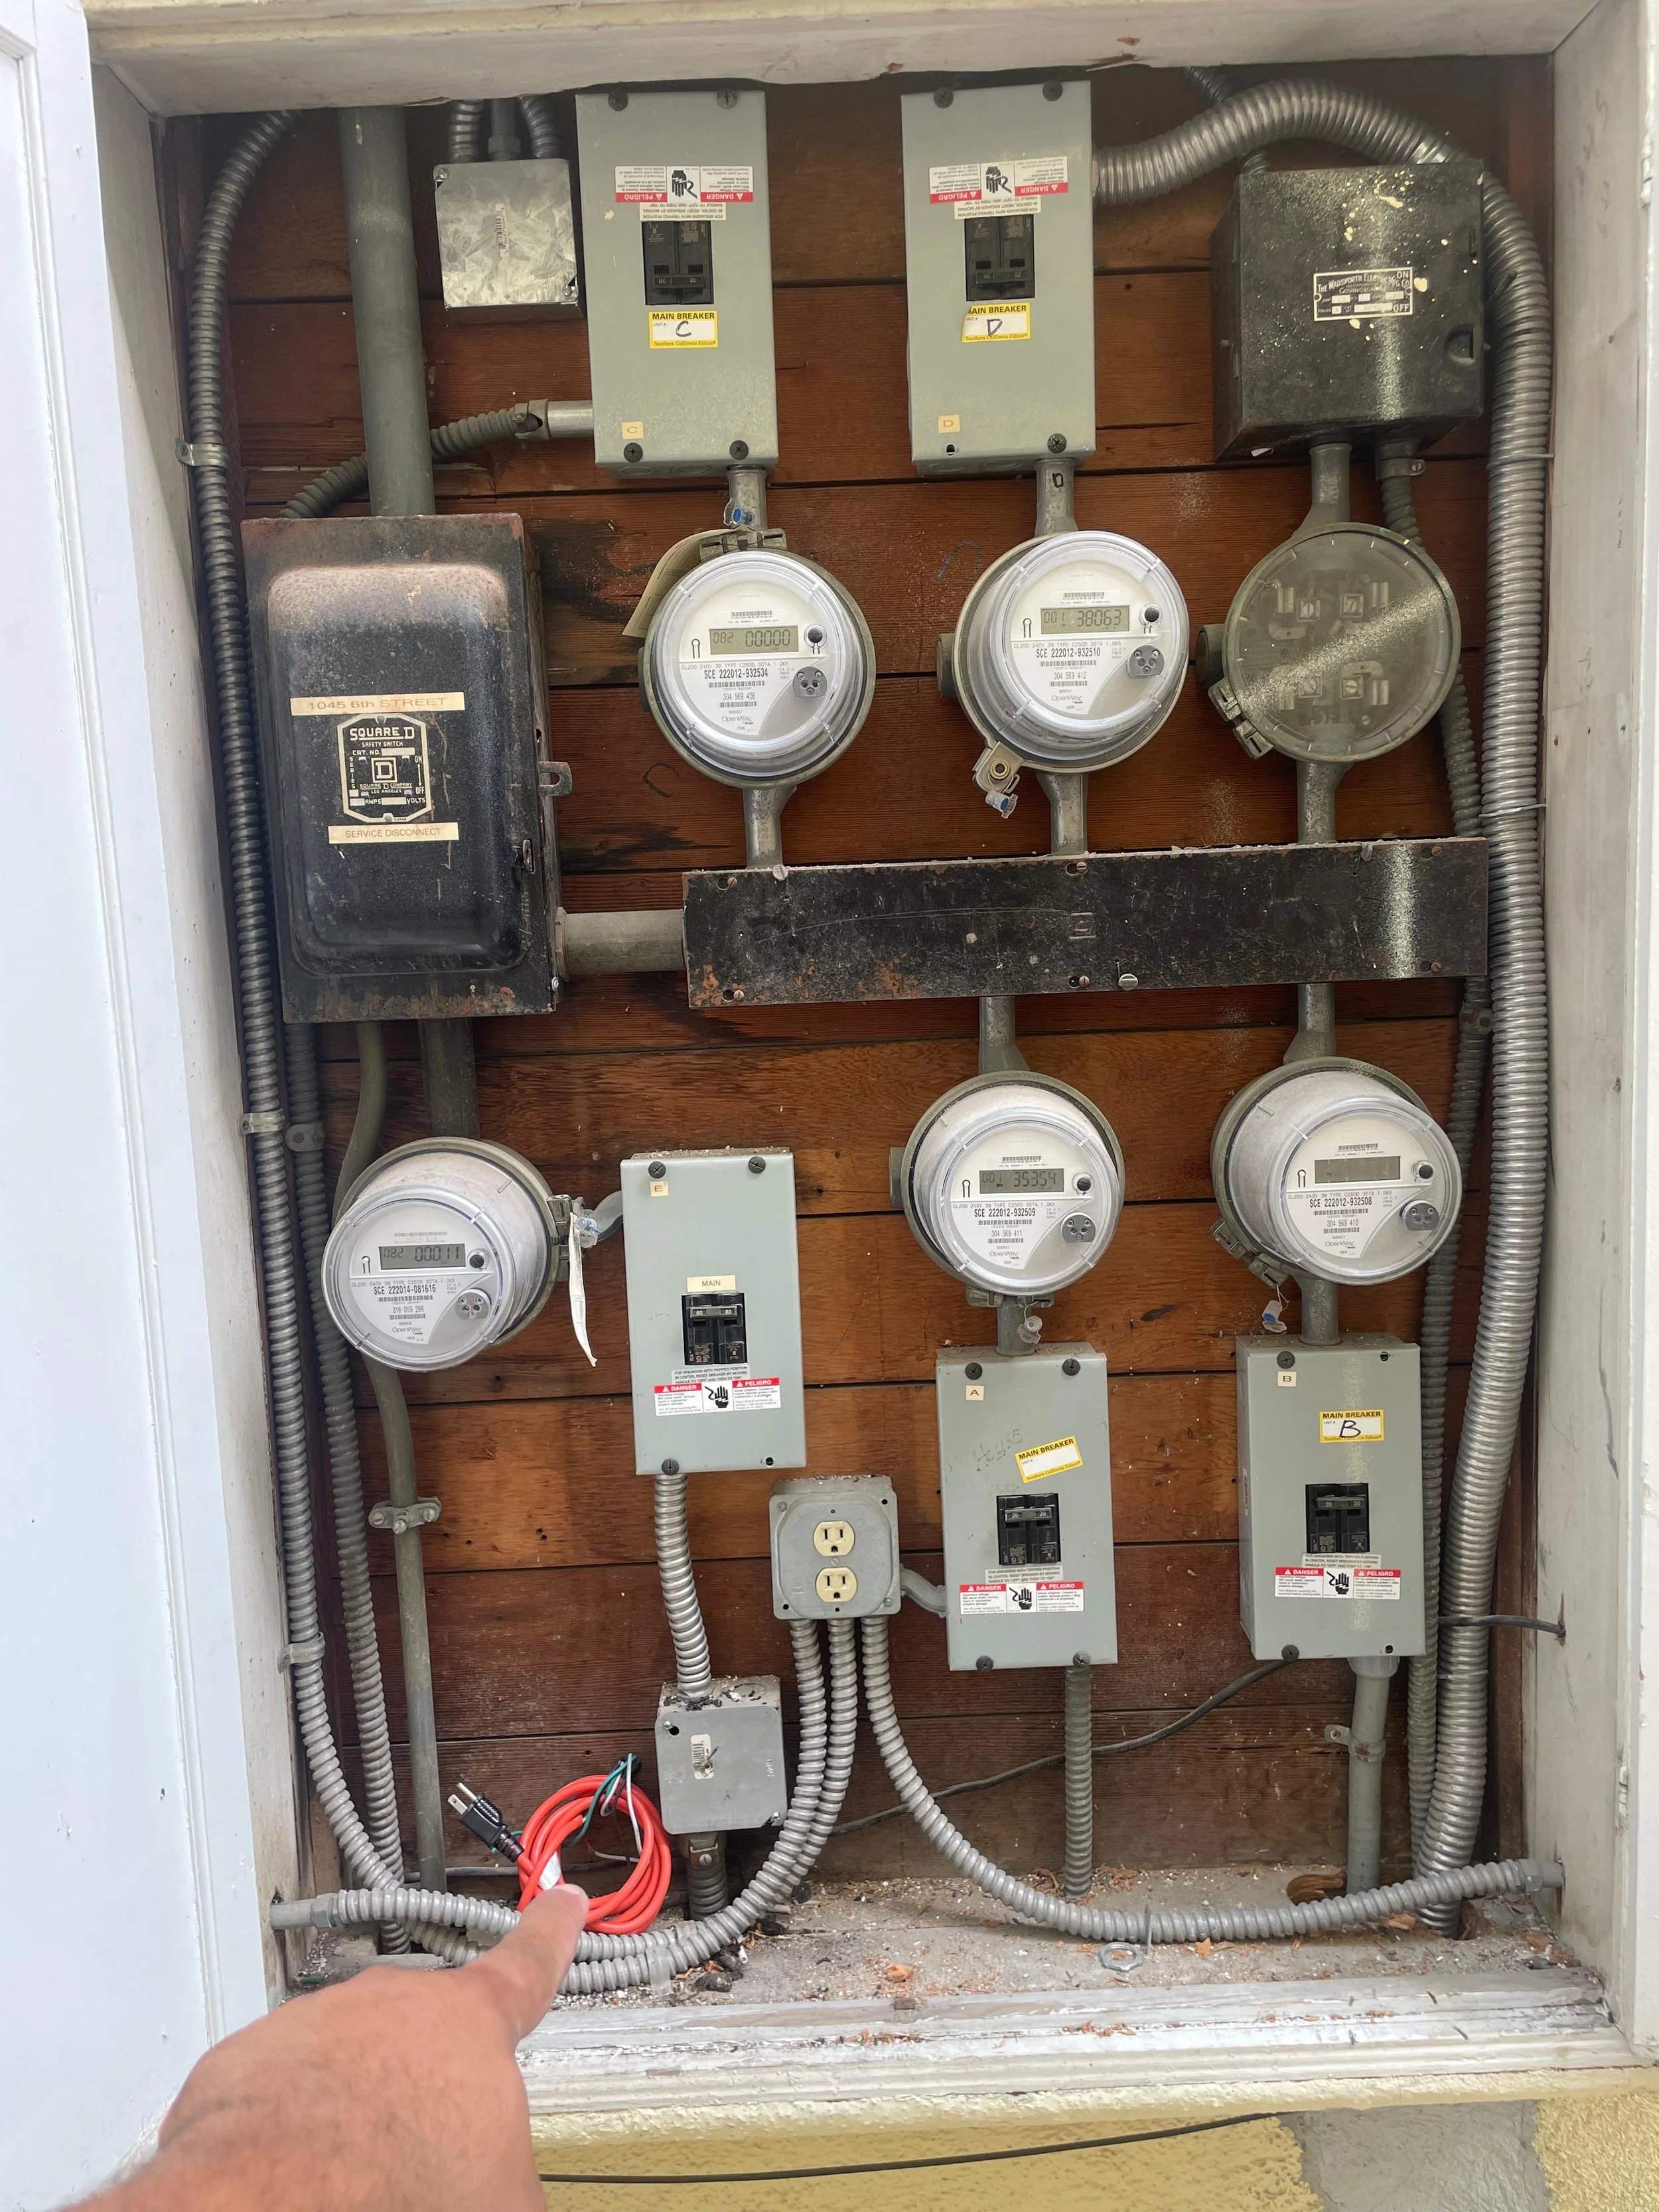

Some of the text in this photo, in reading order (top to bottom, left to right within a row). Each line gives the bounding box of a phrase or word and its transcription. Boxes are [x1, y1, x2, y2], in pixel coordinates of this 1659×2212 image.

[1020, 185, 1049, 194] DANGER
[1317, 284, 1328, 293] THE
[1328, 275, 1362, 289] WADSWORTH
[1393, 303, 1409, 313] OFF
[676, 321, 692, 337] C
[987, 319, 1003, 336] D
[1077, 609, 1121, 627] 38063
[713, 629, 791, 648] 082 00000
[1036, 648, 1047, 658] SCE
[1051, 646, 1100, 658] 222012-932510
[704, 670, 715, 680] SCE
[719, 668, 768, 679] 222012-932534
[309, 698, 447, 709] 1045 6th STREET
[350, 726, 415, 741] SQUARE D
[376, 761, 394, 779] D
[345, 828, 441, 838] SERVICE DISCONNECT
[1013, 1171, 1056, 1187] 35354
[1309, 1199, 1321, 1208] SCE
[1325, 1197, 1372, 1207] 222012-932508
[974, 1208, 985, 1217] SCE
[989, 1207, 1036, 1217] 222012-932509
[384, 1246, 459, 1262] 082 00011
[374, 1284, 436, 1295] SCE 222014-081616
[1339, 1420, 1361, 1438] B
[1019, 1438, 1074, 1459] MAIN BREAKER
